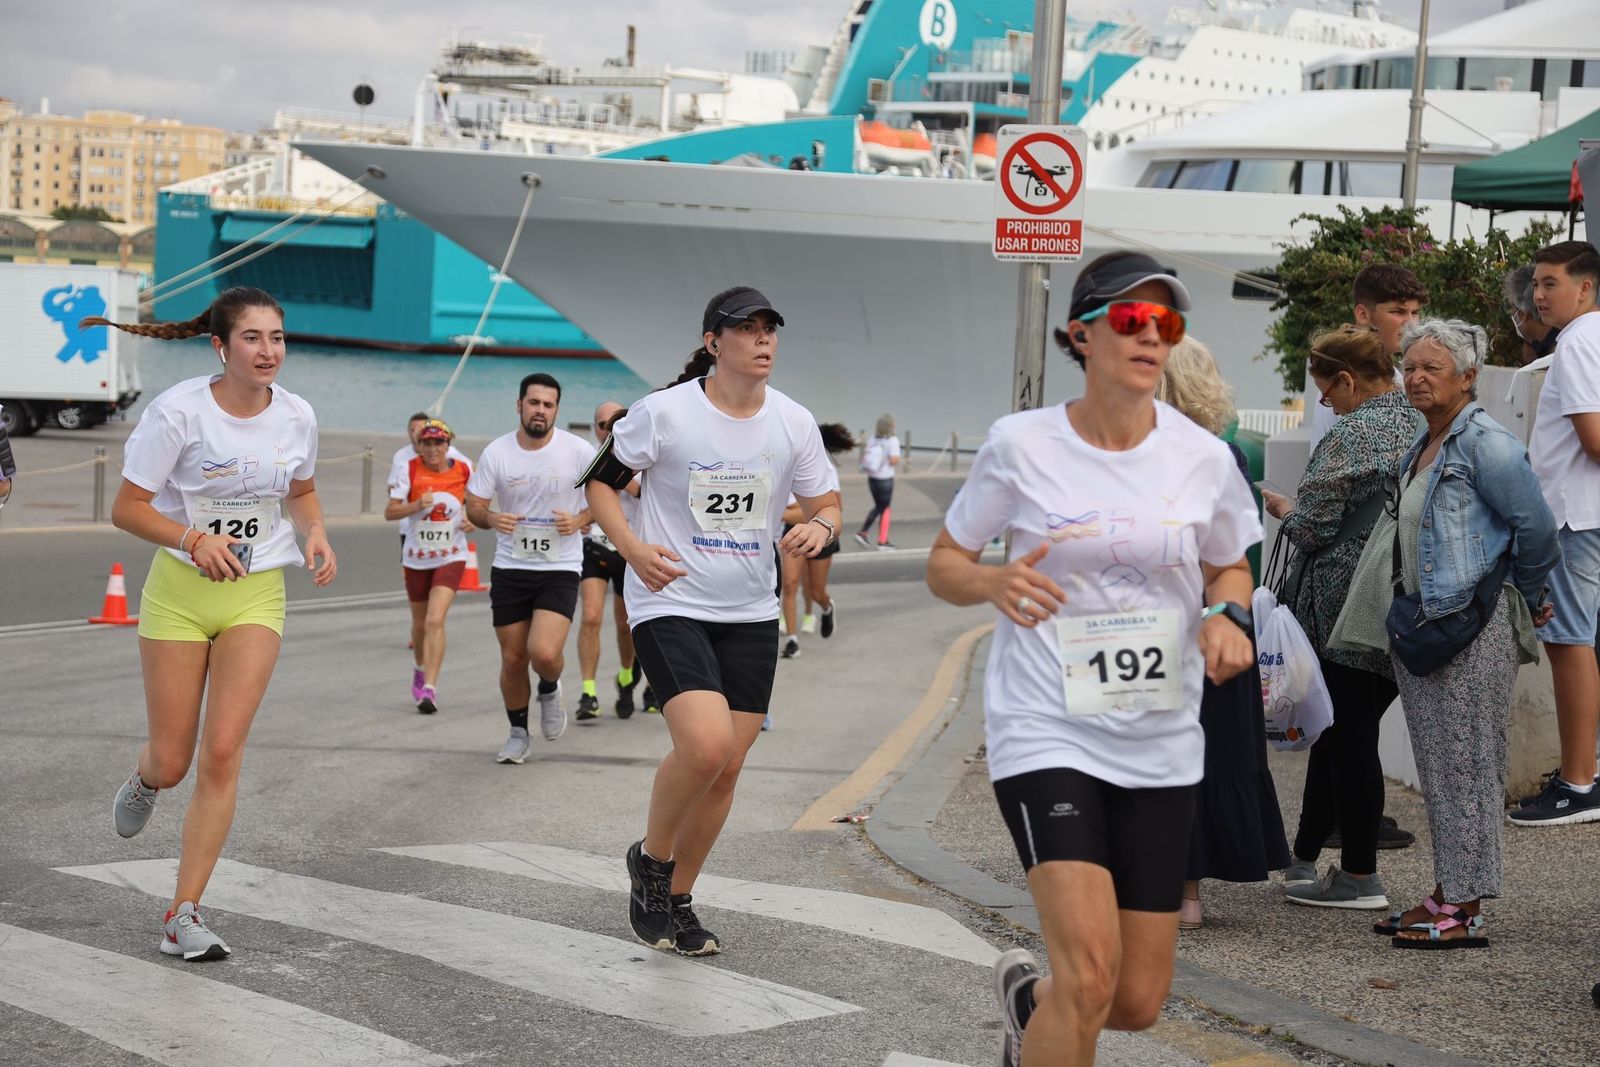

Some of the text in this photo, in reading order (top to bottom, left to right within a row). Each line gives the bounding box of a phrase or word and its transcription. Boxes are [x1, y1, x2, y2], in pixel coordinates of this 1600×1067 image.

[930, 3, 946, 37] B
[1006, 220, 1072, 236] PROHIBIDO
[996, 237, 1080, 252] USAR DRONES
[705, 492, 755, 514] 231
[208, 517, 259, 539] 126
[418, 530, 451, 541] 1071
[520, 537, 551, 551] 115
[1100, 616, 1146, 627] CARRERA
[1088, 646, 1167, 684] 192
